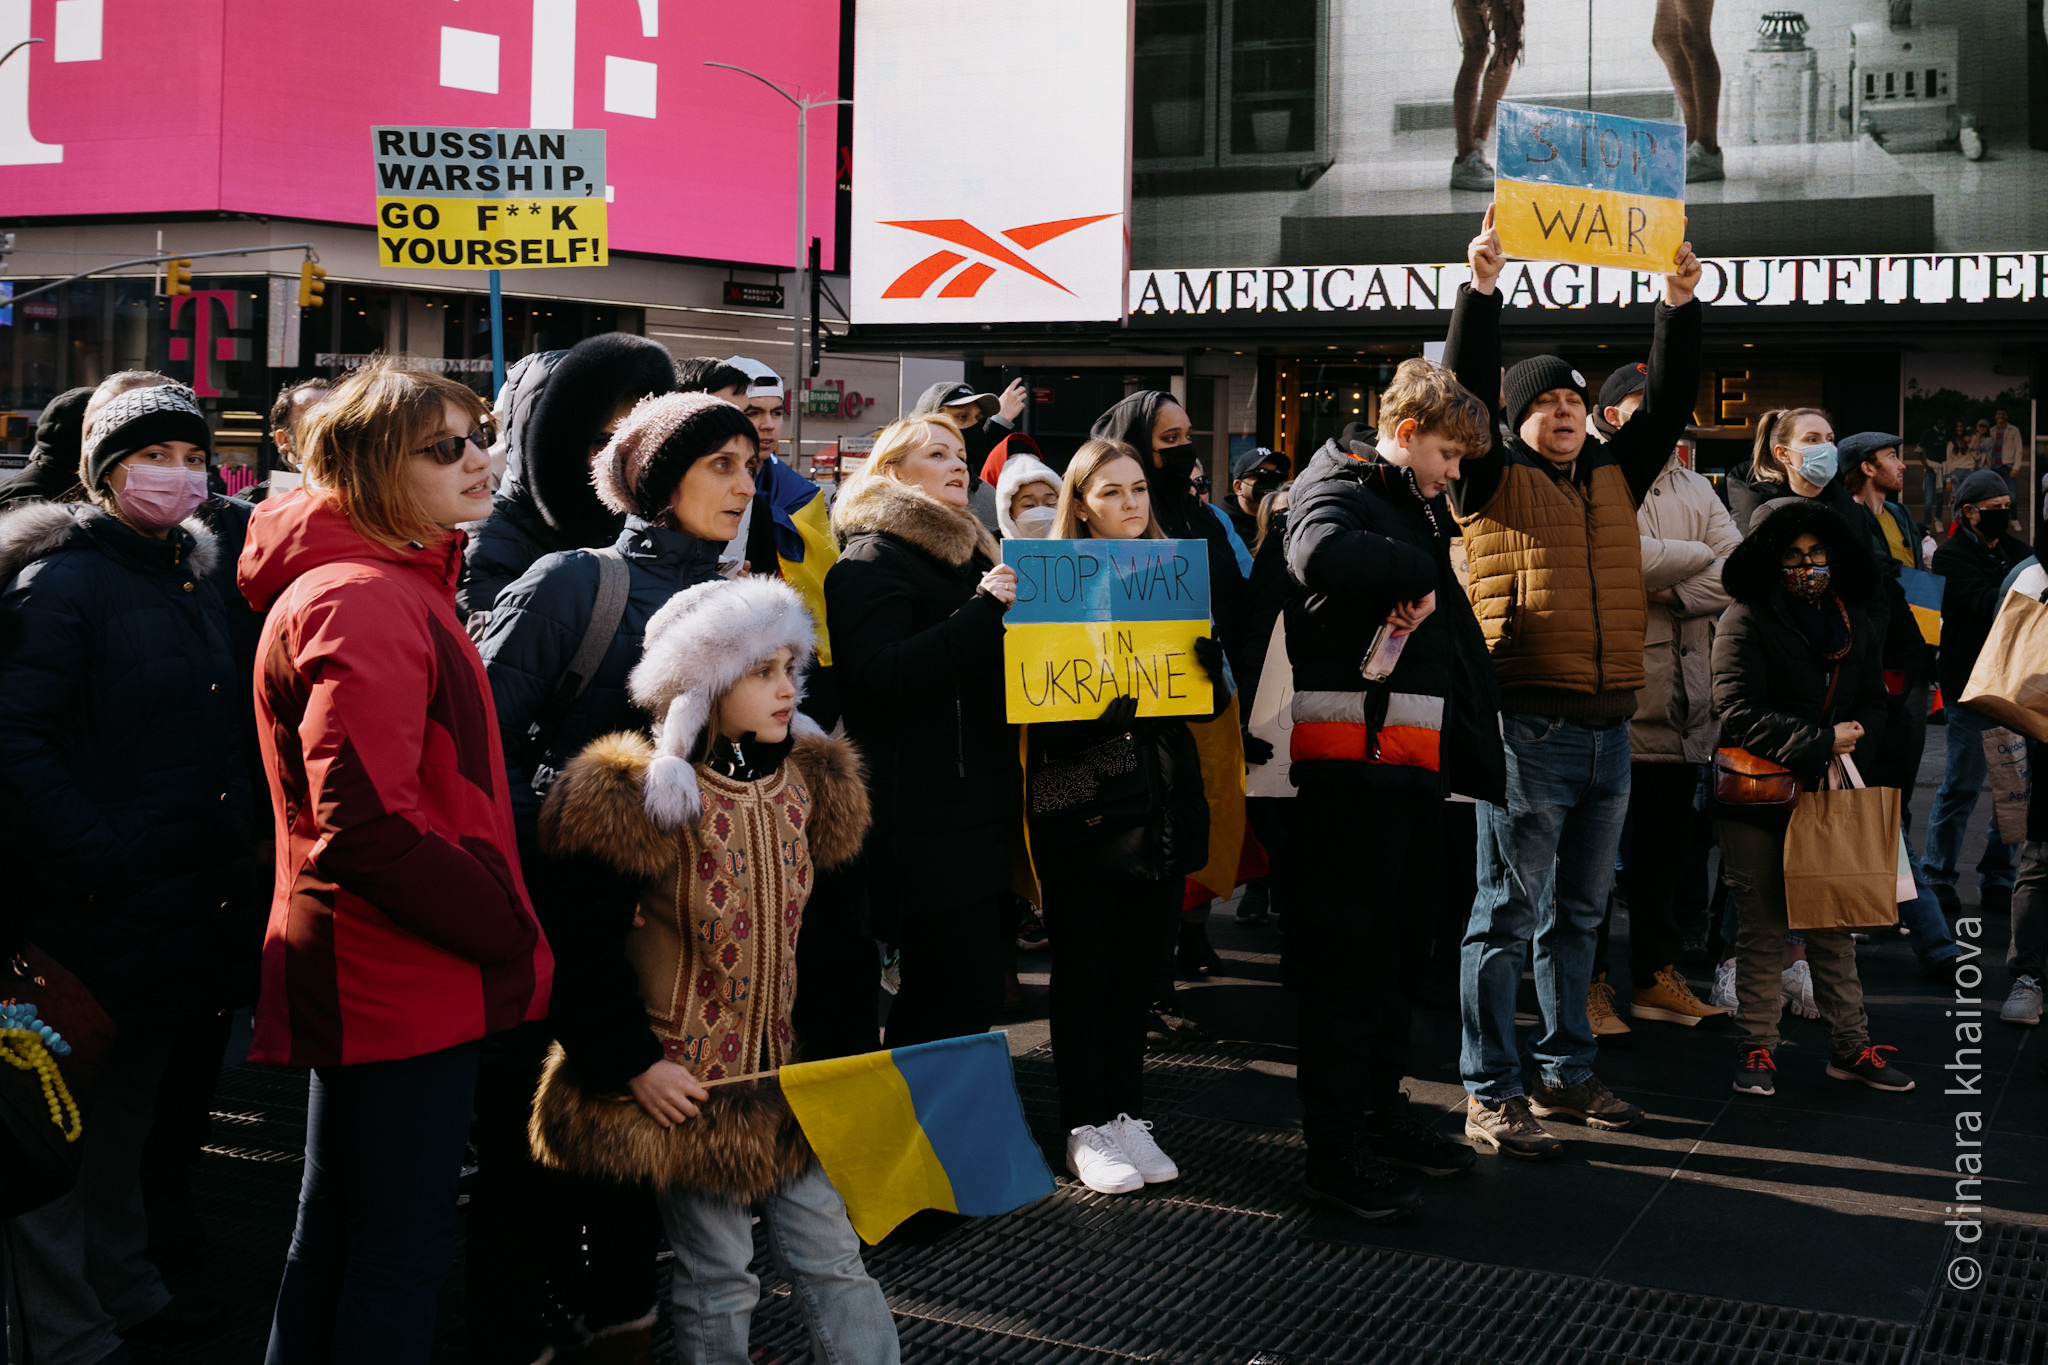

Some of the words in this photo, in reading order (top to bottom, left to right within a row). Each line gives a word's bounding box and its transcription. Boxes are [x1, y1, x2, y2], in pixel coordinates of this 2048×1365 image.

[378, 130, 565, 160] RUSSIAN
[1526, 122, 1658, 176] STOP
[378, 163, 593, 196] WARSHIP,
[381, 202, 440, 230] GO
[1532, 201, 1646, 254] WAR
[381, 237, 600, 265] YOURSELF!
[1131, 266, 1446, 313] AMERICAN
[809, 391, 841, 403] Broadway
[810, 403, 817, 412] W
[819, 402, 829, 412] 46
[1016, 555, 1099, 603] STOP
[1110, 554, 1194, 601] WAR
[1102, 630, 1133, 655] IN
[1021, 652, 1188, 707] UKRAINE
